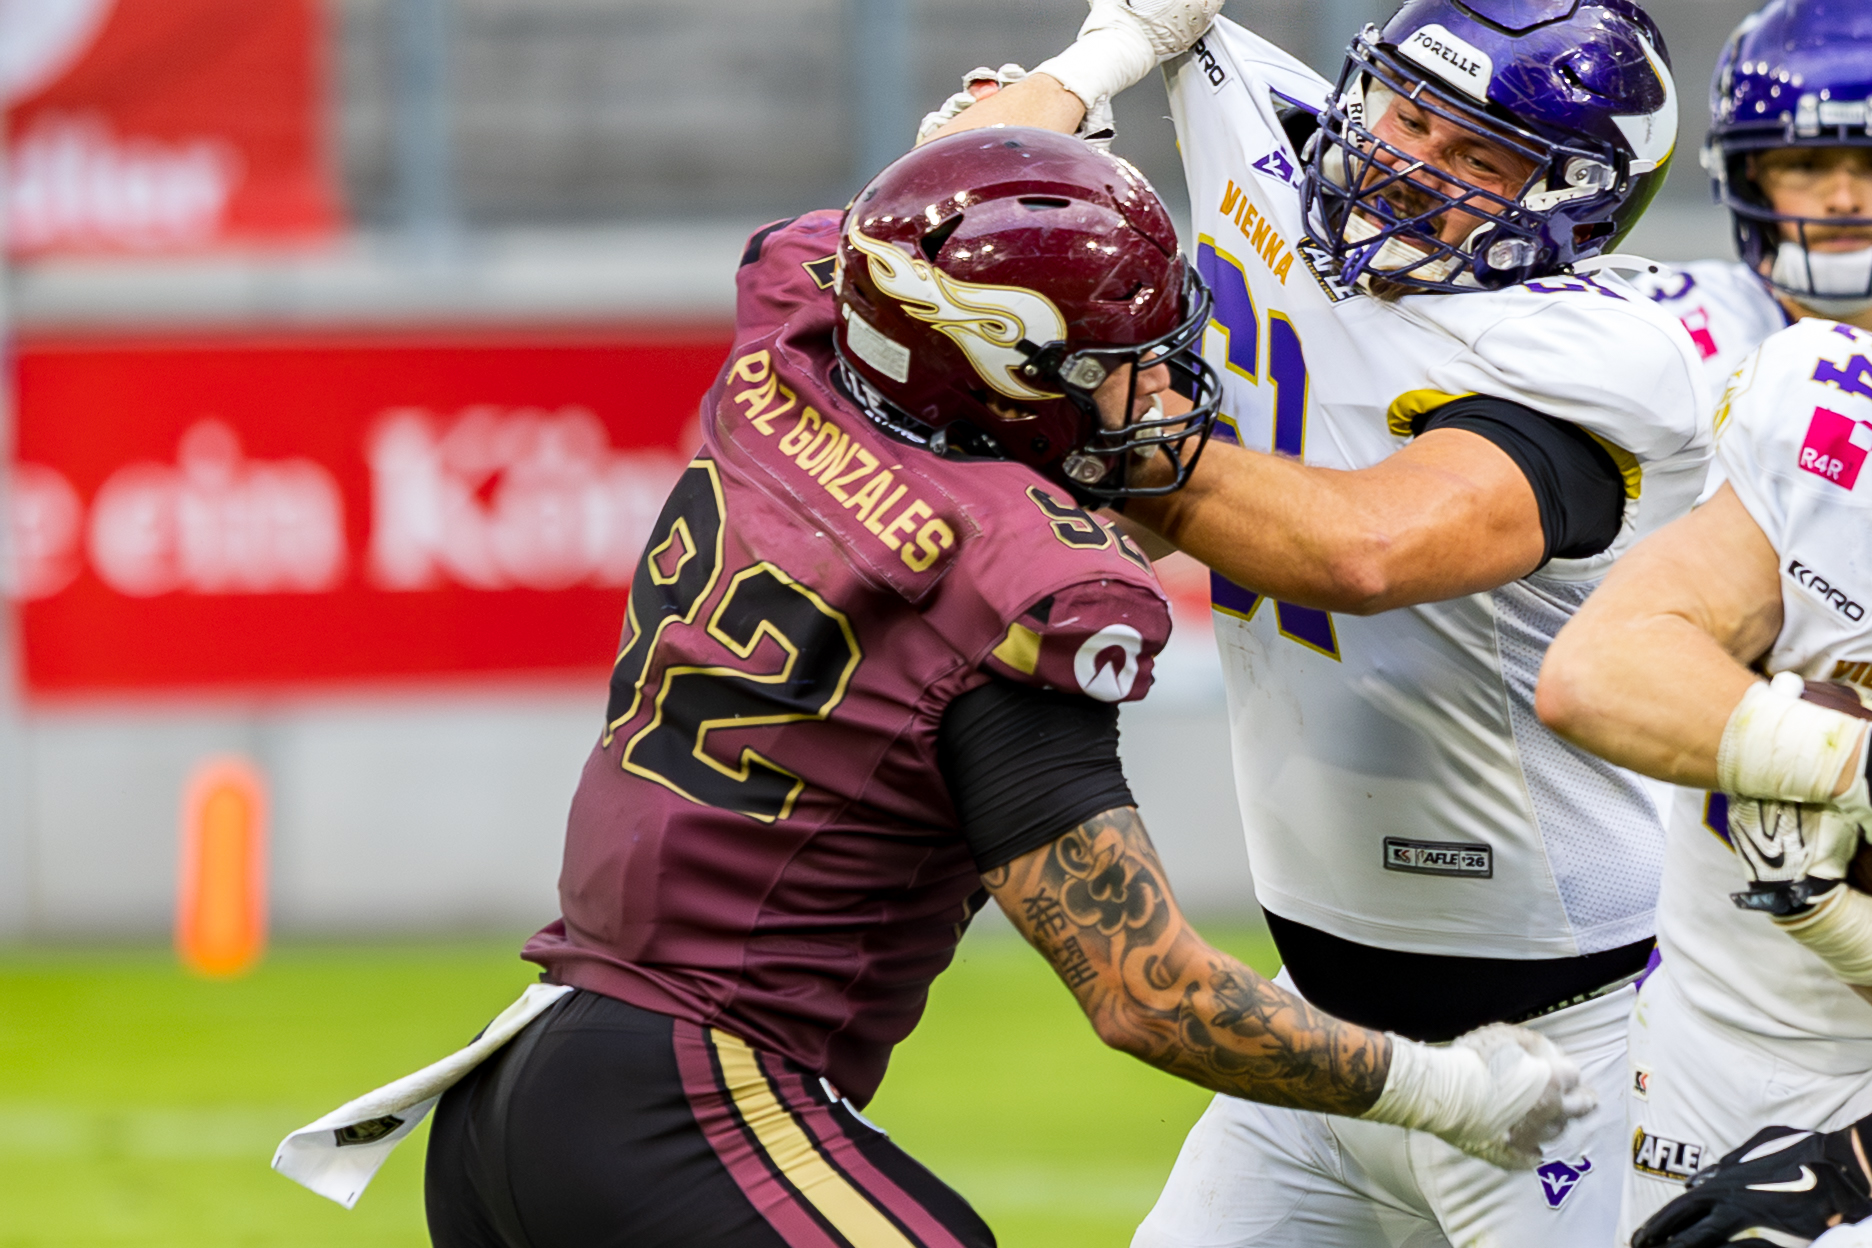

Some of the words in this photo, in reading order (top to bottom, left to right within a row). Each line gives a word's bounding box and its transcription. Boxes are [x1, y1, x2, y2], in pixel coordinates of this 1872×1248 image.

[1194, 38, 1226, 87] PRO
[1413, 31, 1481, 78] FORELLE
[1219, 179, 1295, 287] VIENNA
[727, 349, 798, 436] PAZ
[778, 405, 955, 573] GONZÁLES
[1800, 447, 1845, 480] R4R
[1787, 559, 1865, 623] KPRO
[601, 455, 863, 826] 92
[1422, 851, 1459, 866] AFLE
[1636, 1134, 1700, 1174] AFLE
